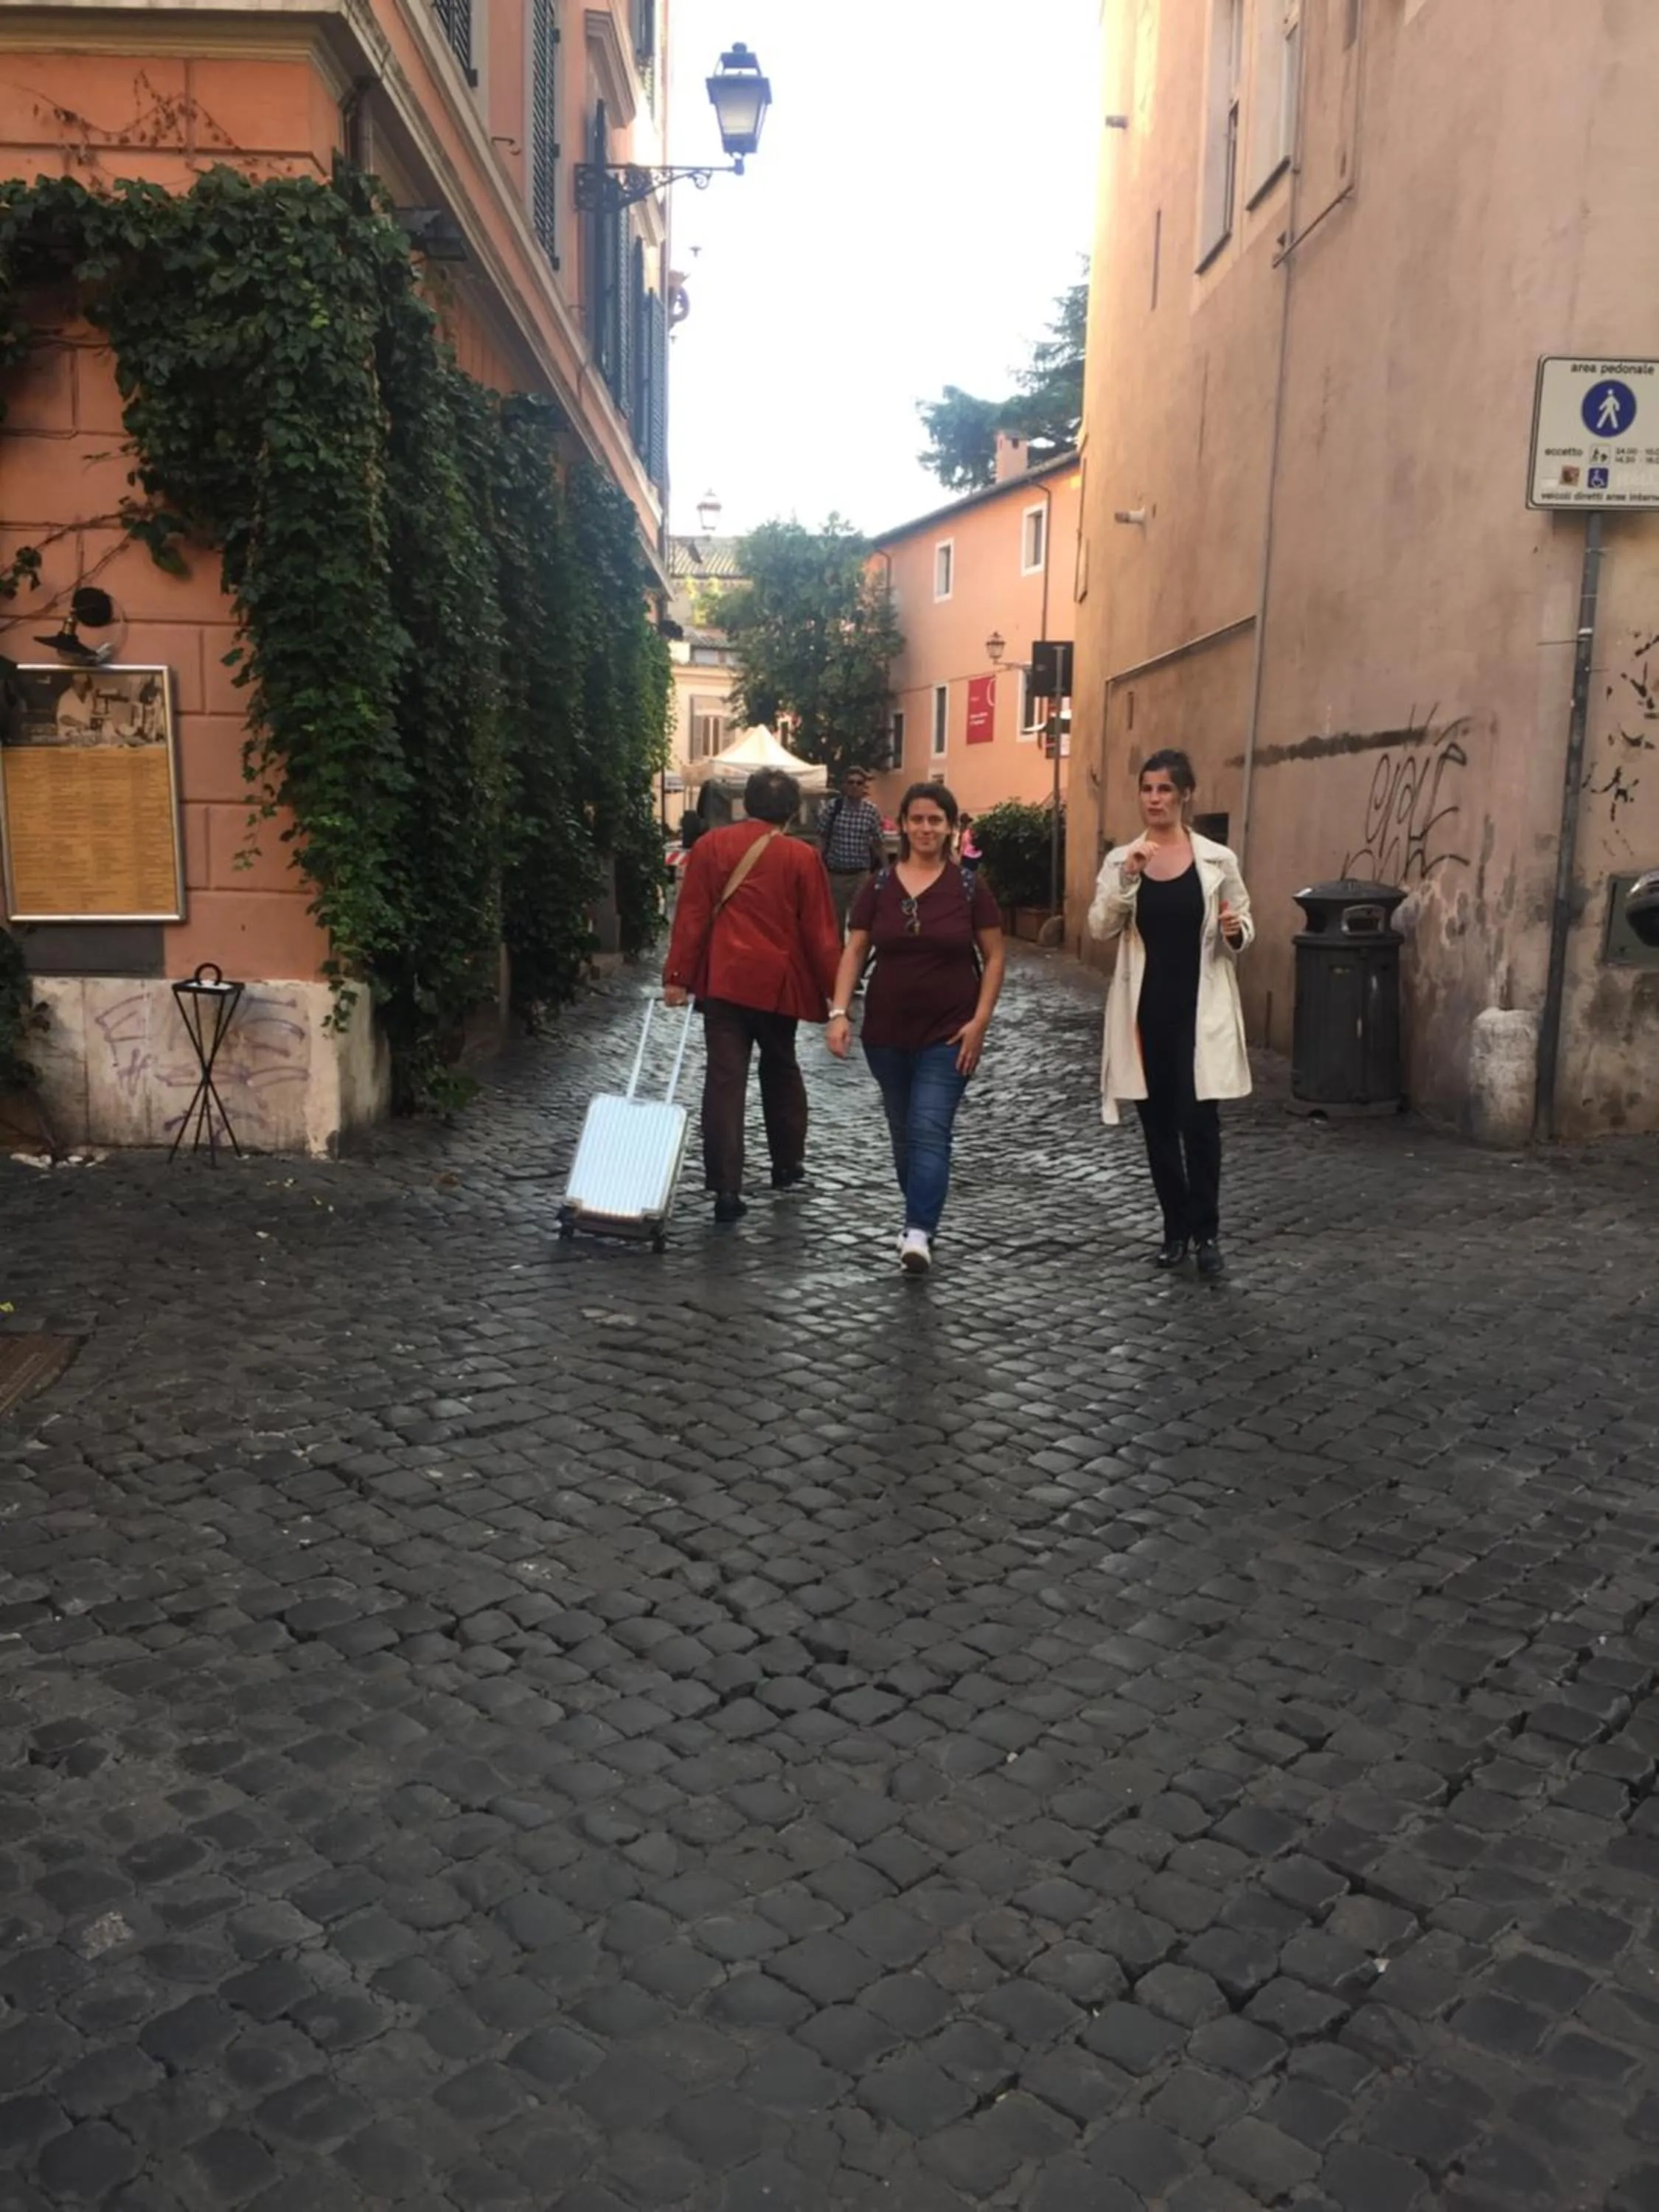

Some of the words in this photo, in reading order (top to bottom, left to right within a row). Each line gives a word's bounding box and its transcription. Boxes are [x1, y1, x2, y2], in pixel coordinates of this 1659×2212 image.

[1571, 363, 1596, 373] area
[1601, 362, 1655, 375] pedonale
[1545, 447, 1583, 456] eccetto
